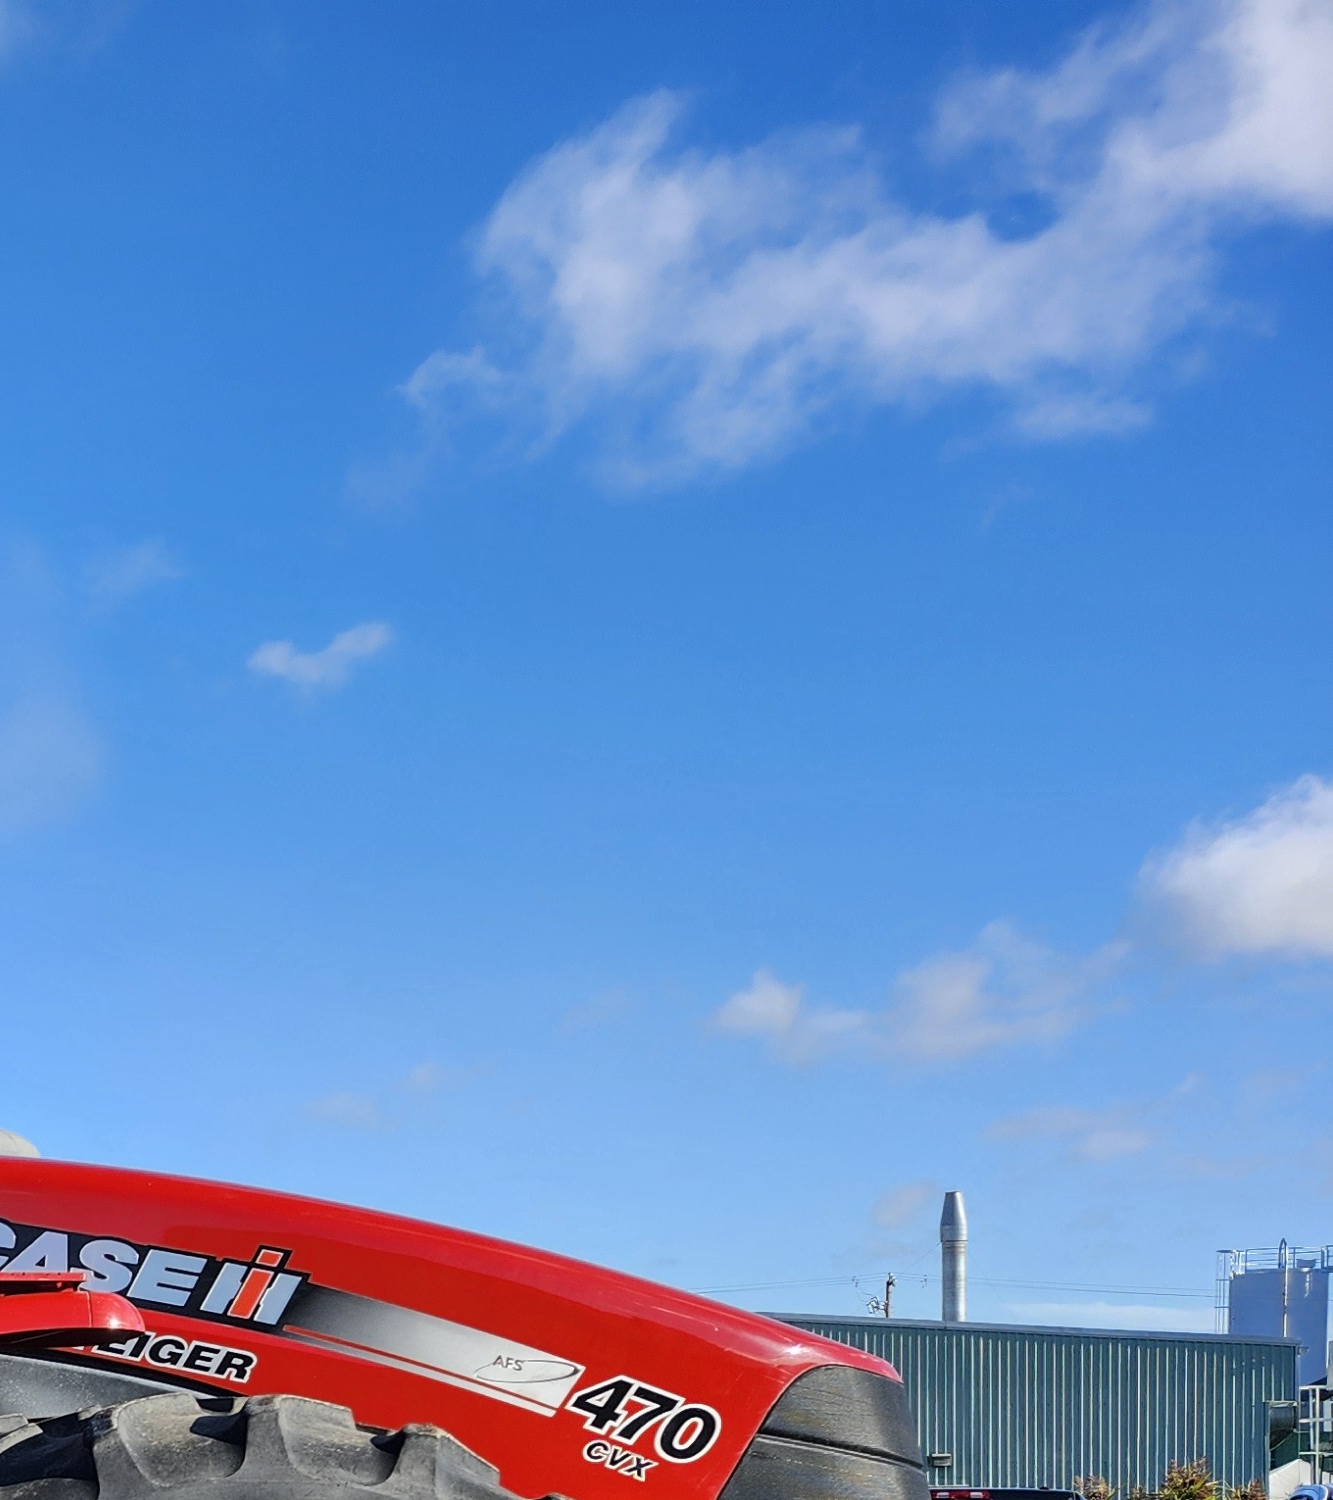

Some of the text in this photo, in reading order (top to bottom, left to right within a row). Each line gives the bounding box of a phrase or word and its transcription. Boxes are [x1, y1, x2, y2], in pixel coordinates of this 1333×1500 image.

[493, 1354, 524, 1371] AFS
[567, 1376, 720, 1462] 470
[584, 1440, 658, 1481] CVX
